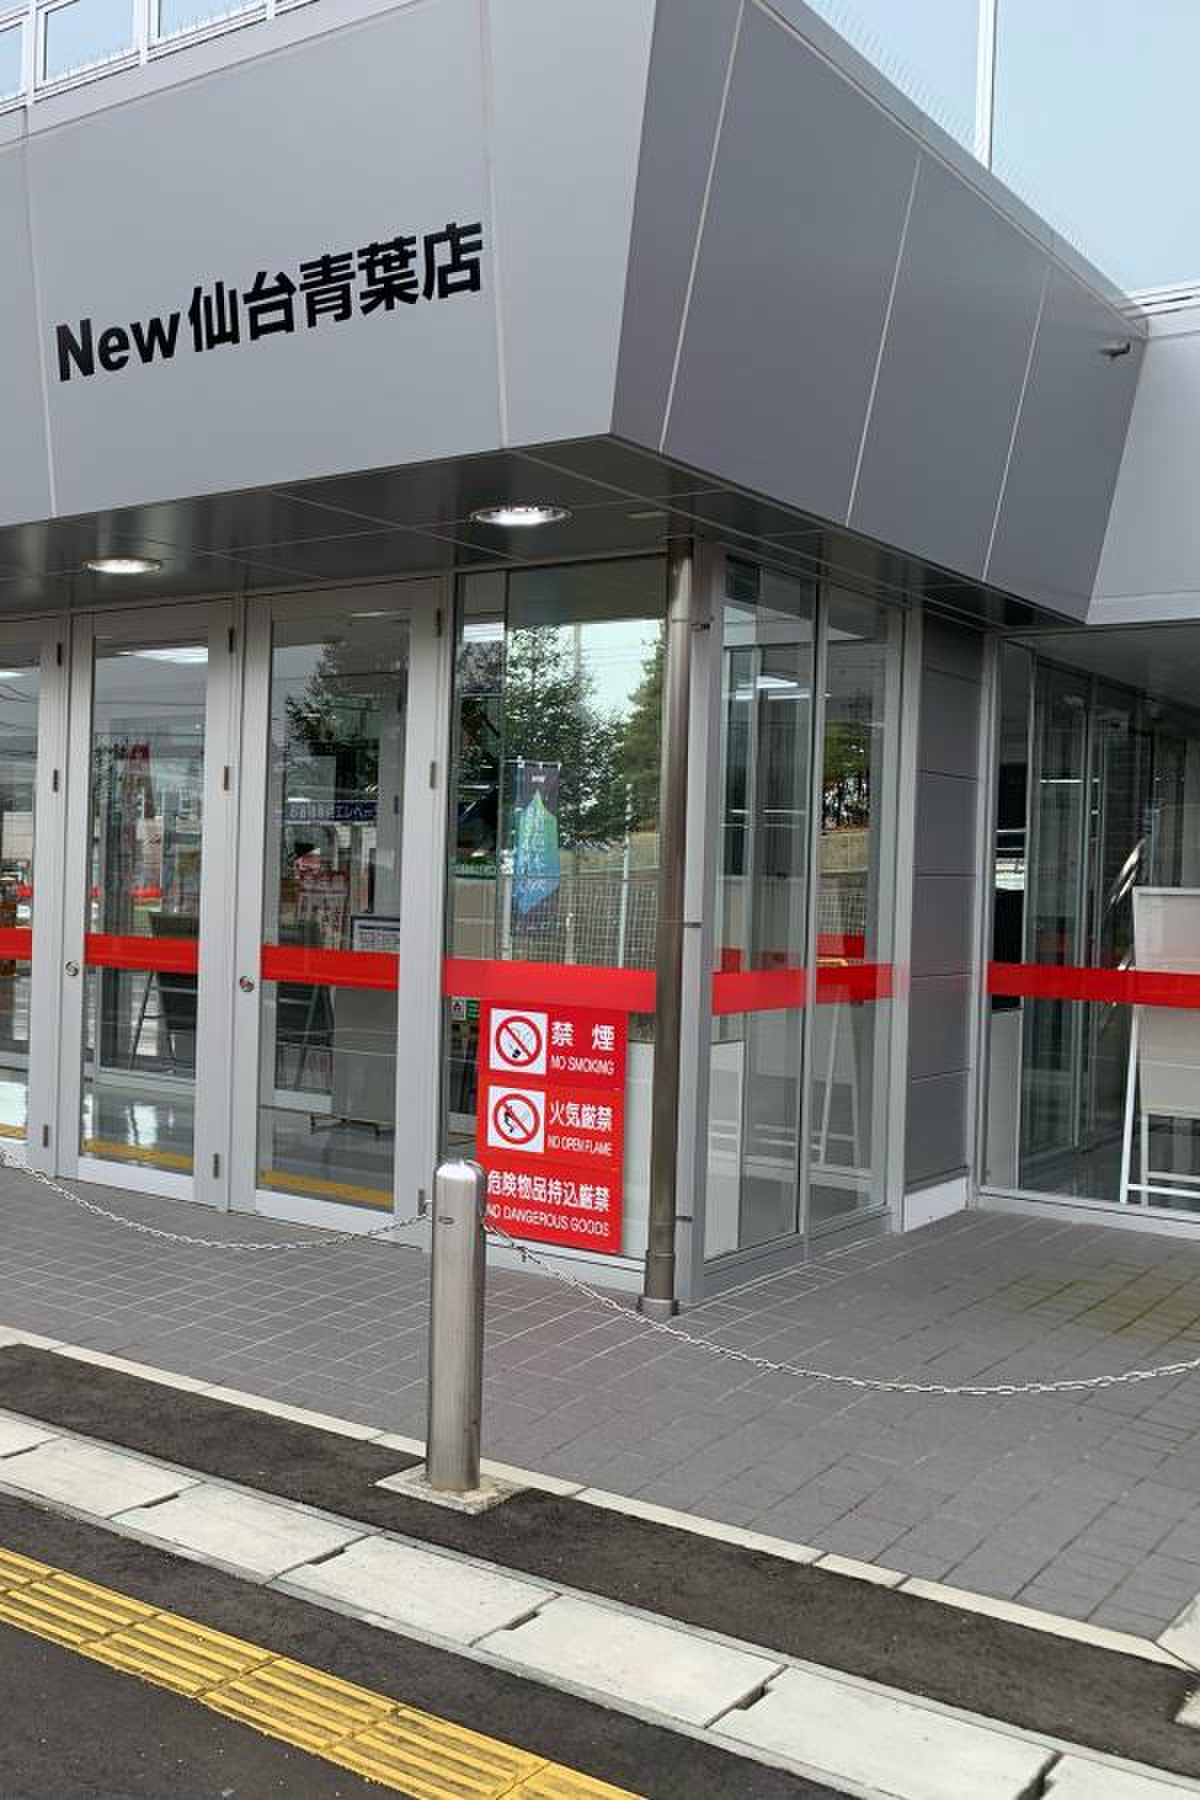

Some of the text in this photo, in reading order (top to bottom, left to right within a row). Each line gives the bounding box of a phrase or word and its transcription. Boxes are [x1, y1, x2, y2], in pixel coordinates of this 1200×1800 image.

[551, 1056, 615, 1076] NO SMOKING
[550, 1100, 613, 1132] 火気厳禁
[548, 1135, 613, 1157] NO OPEN FLAME
[487, 1170, 609, 1212] 危険物品持込厳禁
[503, 1205, 569, 1230] DANGEROUS
[570, 1217, 609, 1237] GOODS
